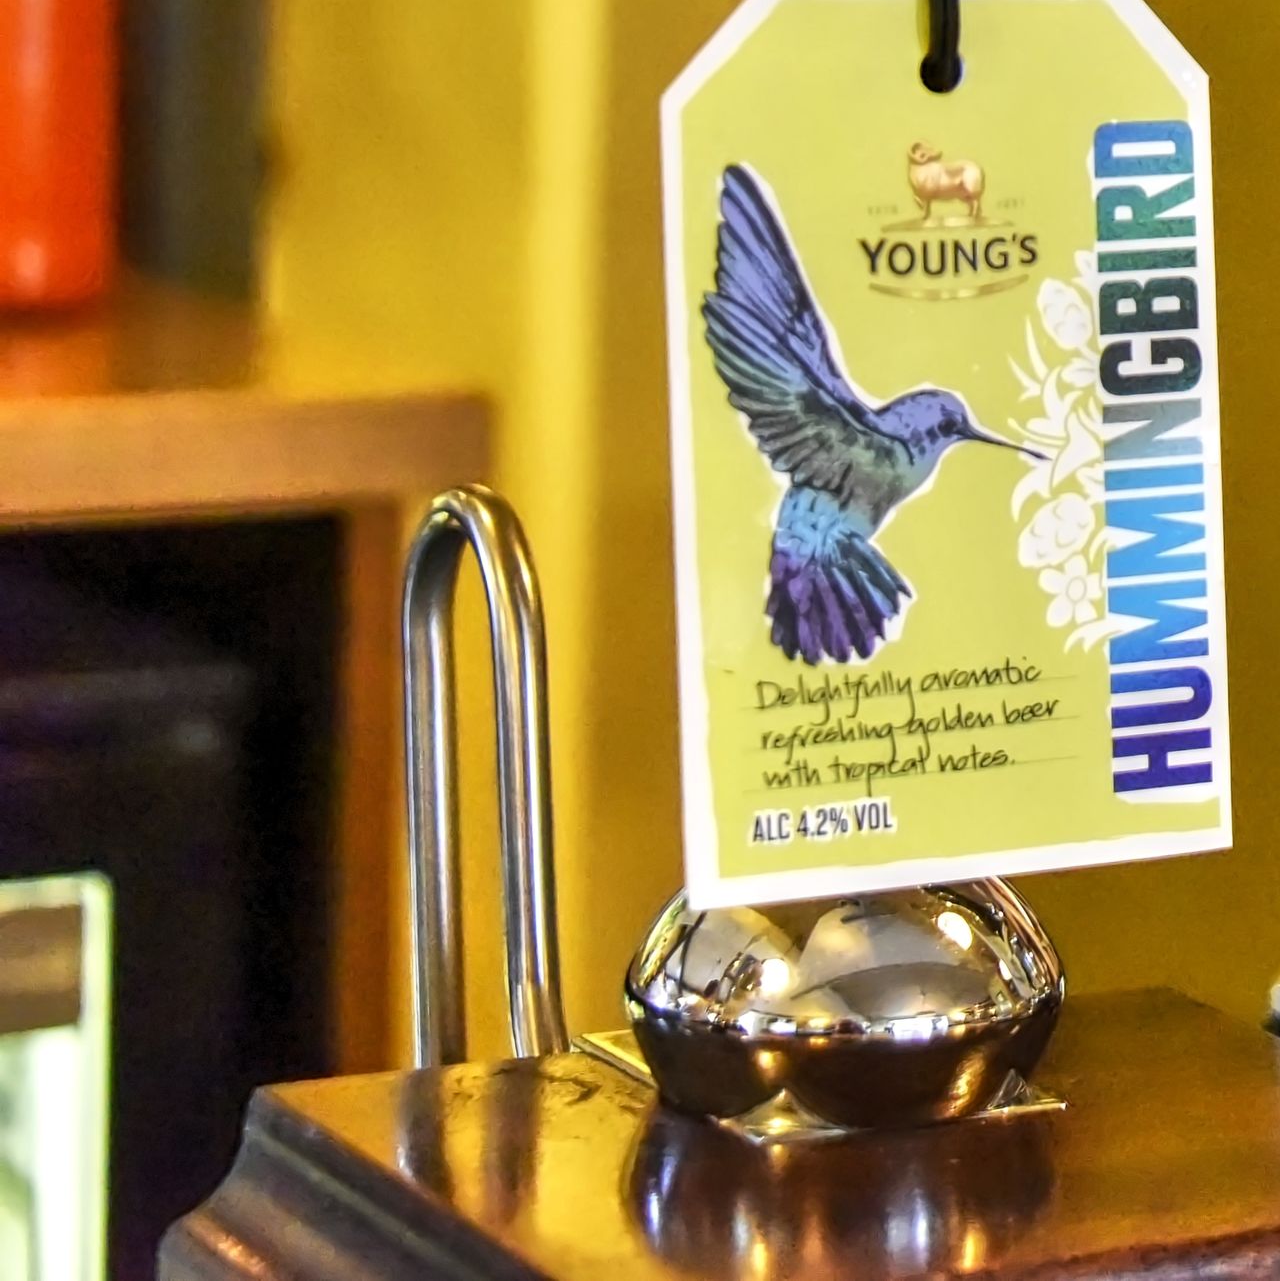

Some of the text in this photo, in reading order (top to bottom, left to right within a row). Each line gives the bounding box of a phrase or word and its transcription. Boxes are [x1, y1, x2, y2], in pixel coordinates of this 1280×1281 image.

[858, 233, 1038, 276] YOUNG'S
[1093, 119, 1213, 794] HUMMINGBIRD
[755, 656, 1043, 725] Delightfully aromatic
[760, 698, 1060, 765] refreshing golden beer
[764, 744, 1016, 797] with tropical notes.
[753, 801, 893, 841] ALC 4.2% VOL
